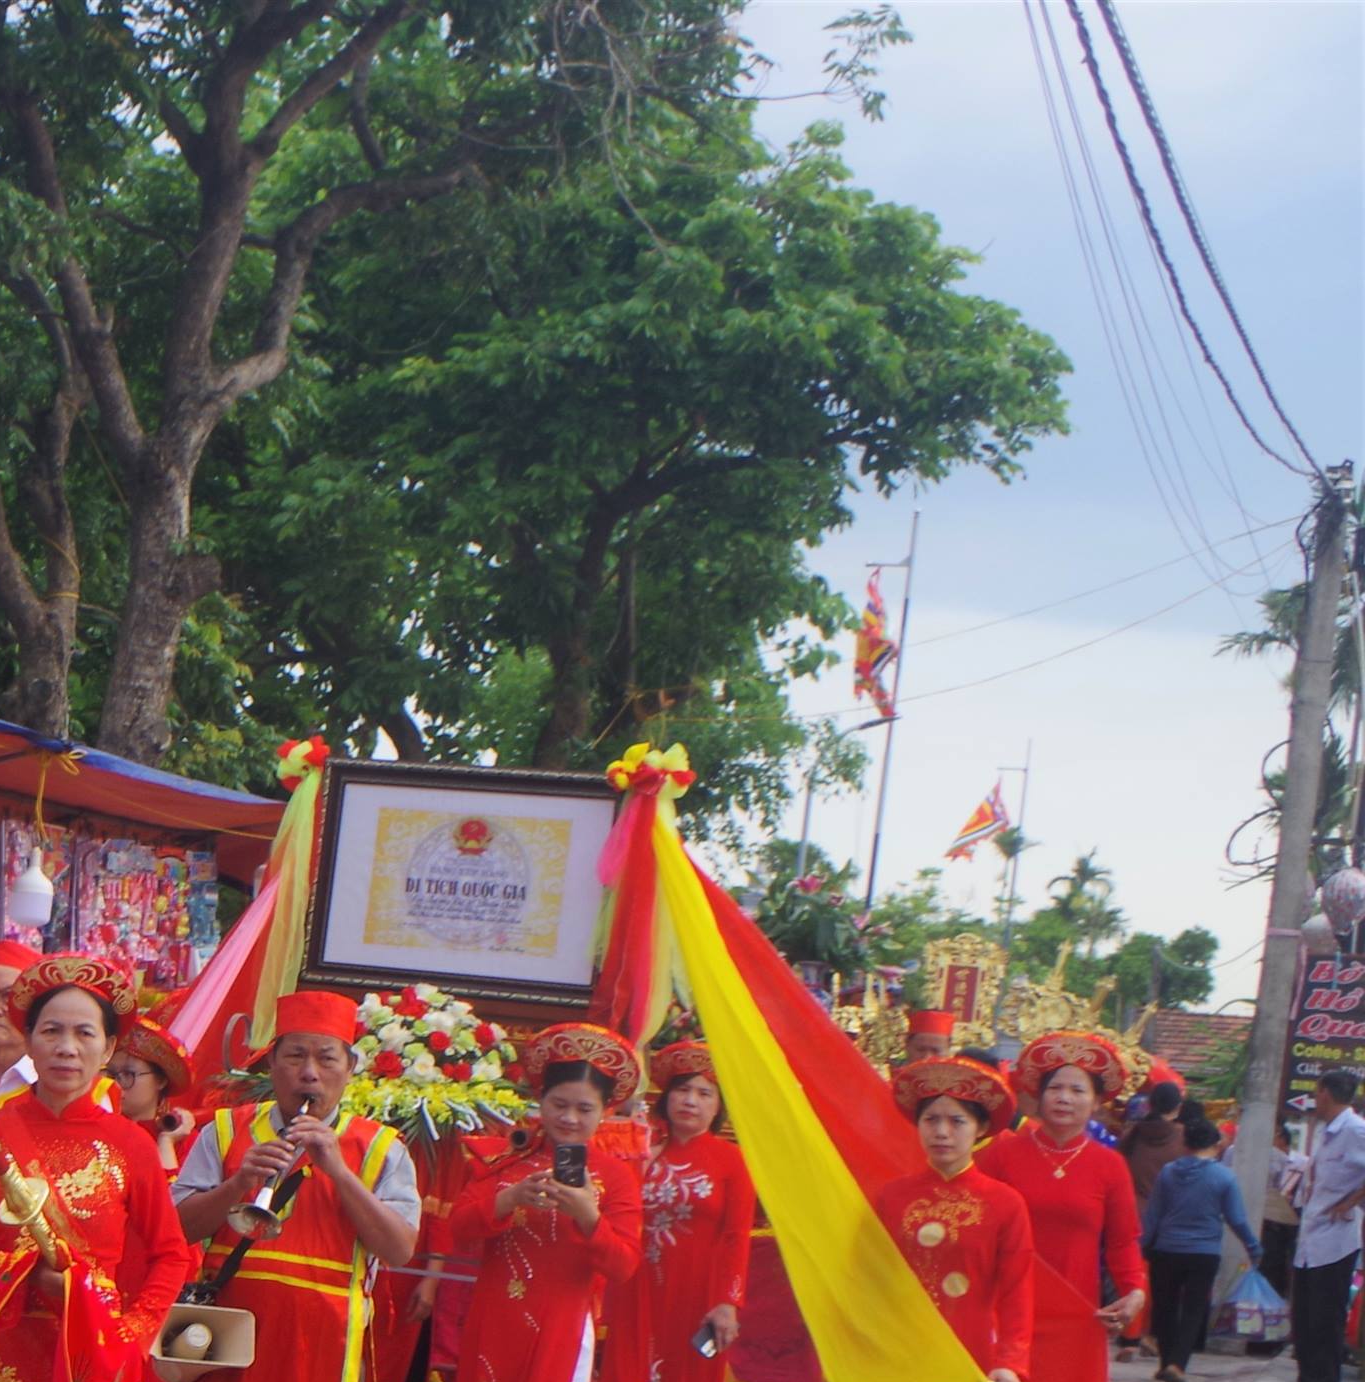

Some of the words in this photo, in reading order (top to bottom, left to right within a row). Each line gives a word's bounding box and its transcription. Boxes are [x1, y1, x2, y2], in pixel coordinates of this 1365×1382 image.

[405, 877, 421, 893] DI
[502, 883, 528, 901] GIA
[1292, 1042, 1343, 1061] Coffee
